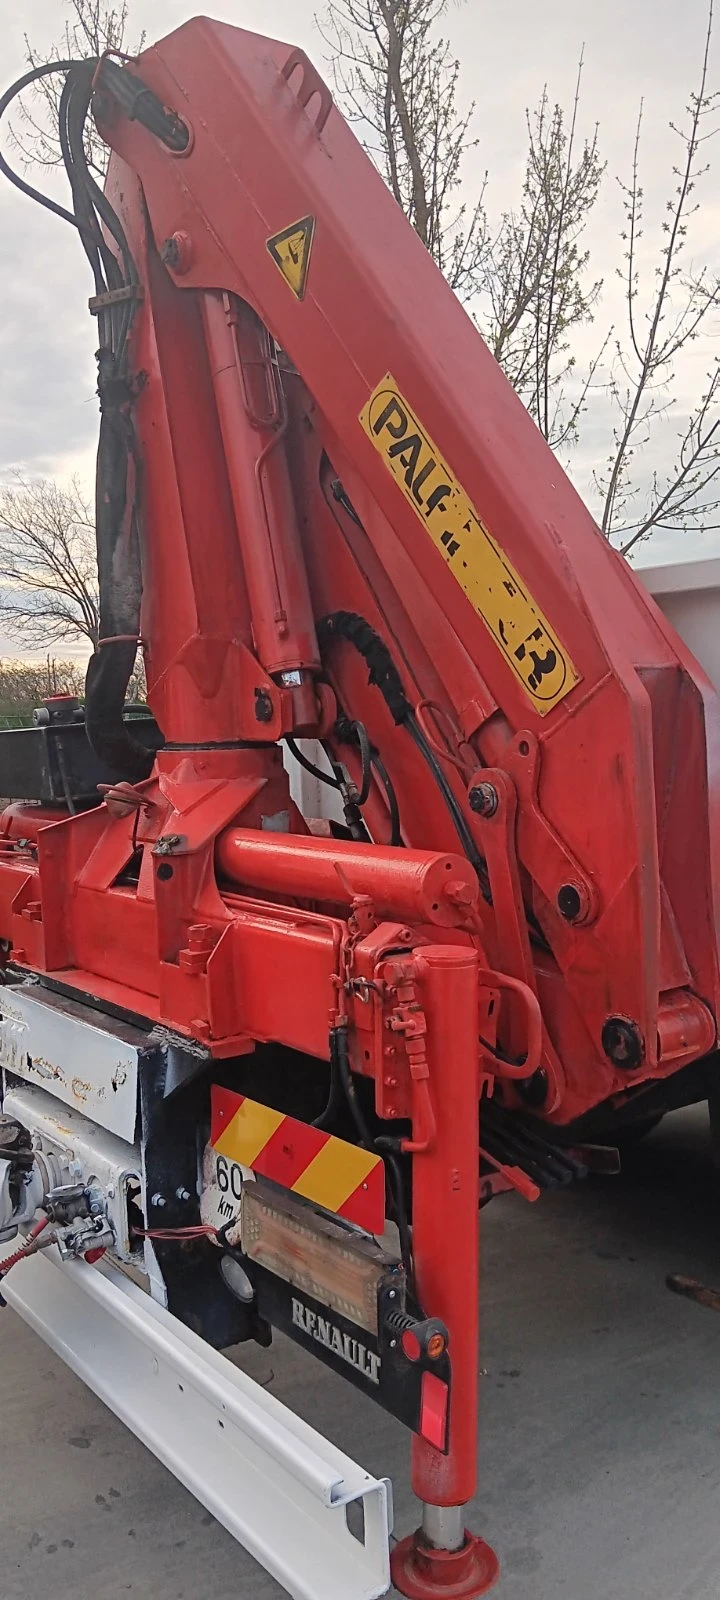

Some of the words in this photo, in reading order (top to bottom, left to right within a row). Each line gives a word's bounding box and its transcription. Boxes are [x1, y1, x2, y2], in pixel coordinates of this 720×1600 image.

[374, 397, 558, 692] PALFR
[217, 1156, 243, 1200] 60
[217, 1196, 234, 1219] km
[292, 1297, 381, 1385] RENAULT
